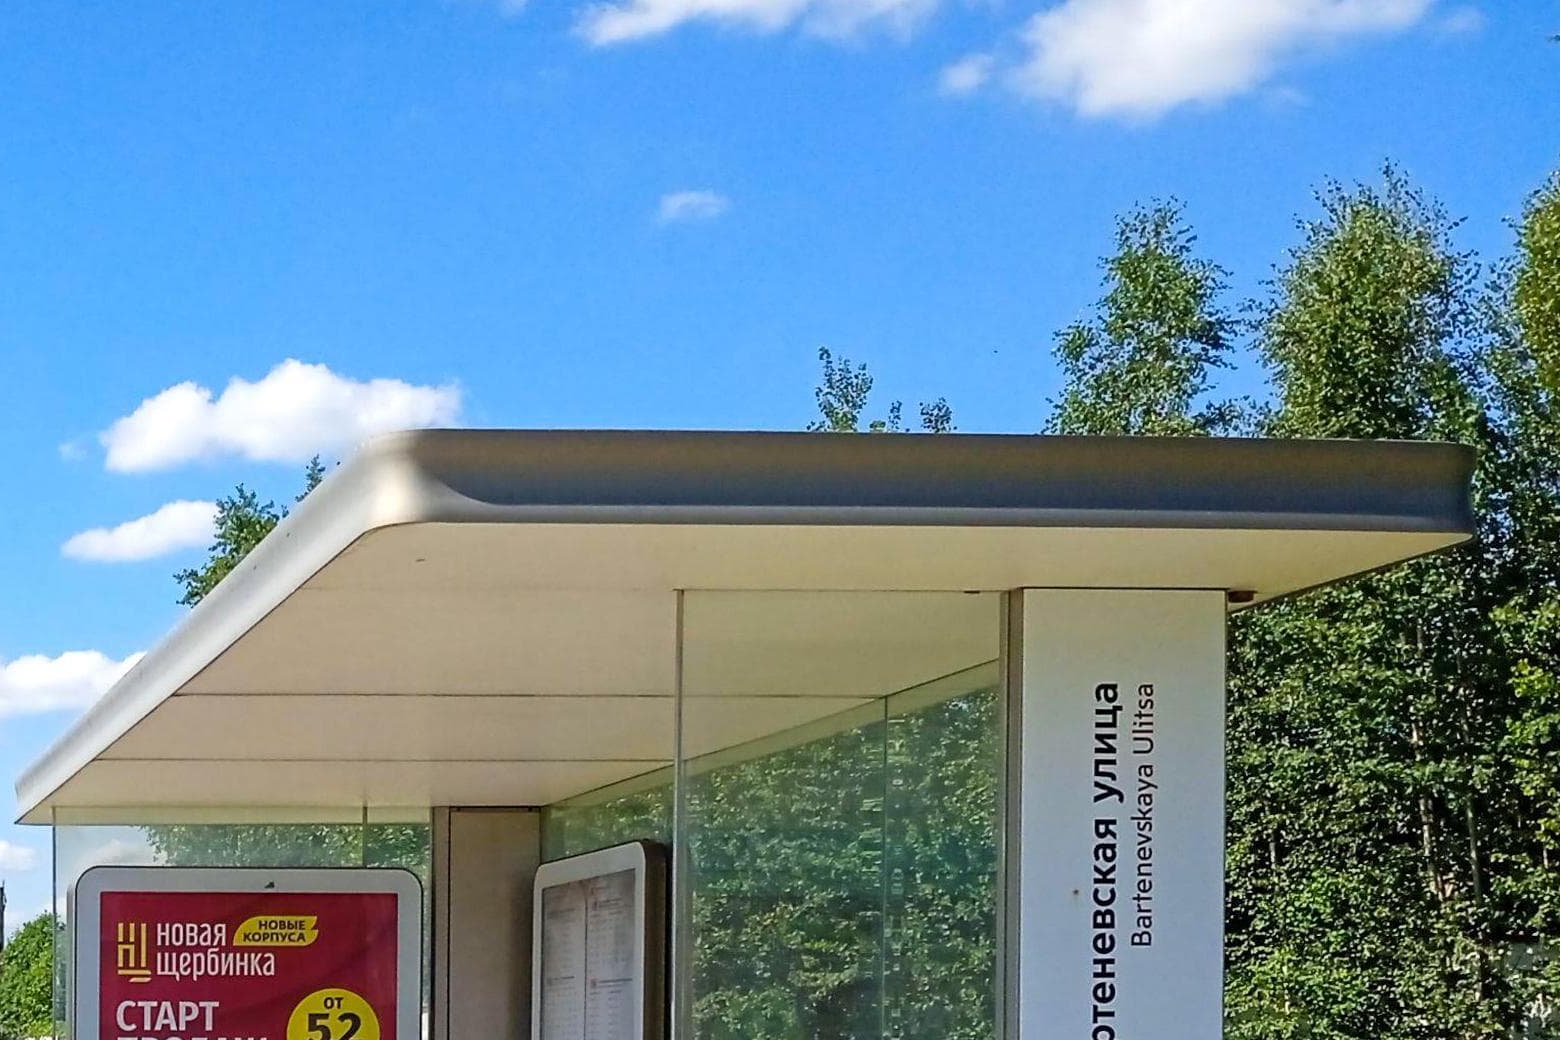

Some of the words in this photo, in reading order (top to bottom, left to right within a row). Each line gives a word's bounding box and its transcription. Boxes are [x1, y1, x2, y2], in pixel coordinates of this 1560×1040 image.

[1131, 683, 1154, 755] Ulitsa
[1093, 682, 1124, 803] улица
[1130, 764, 1159, 947] Bartenevskaya
[242, 931, 307, 943] КОРПУСА
[258, 920, 307, 931] НОВЫЕ
[156, 947, 276, 982] щербинка
[116, 1000, 220, 1032] СТАРТ
[323, 996, 345, 1010] ОТ
